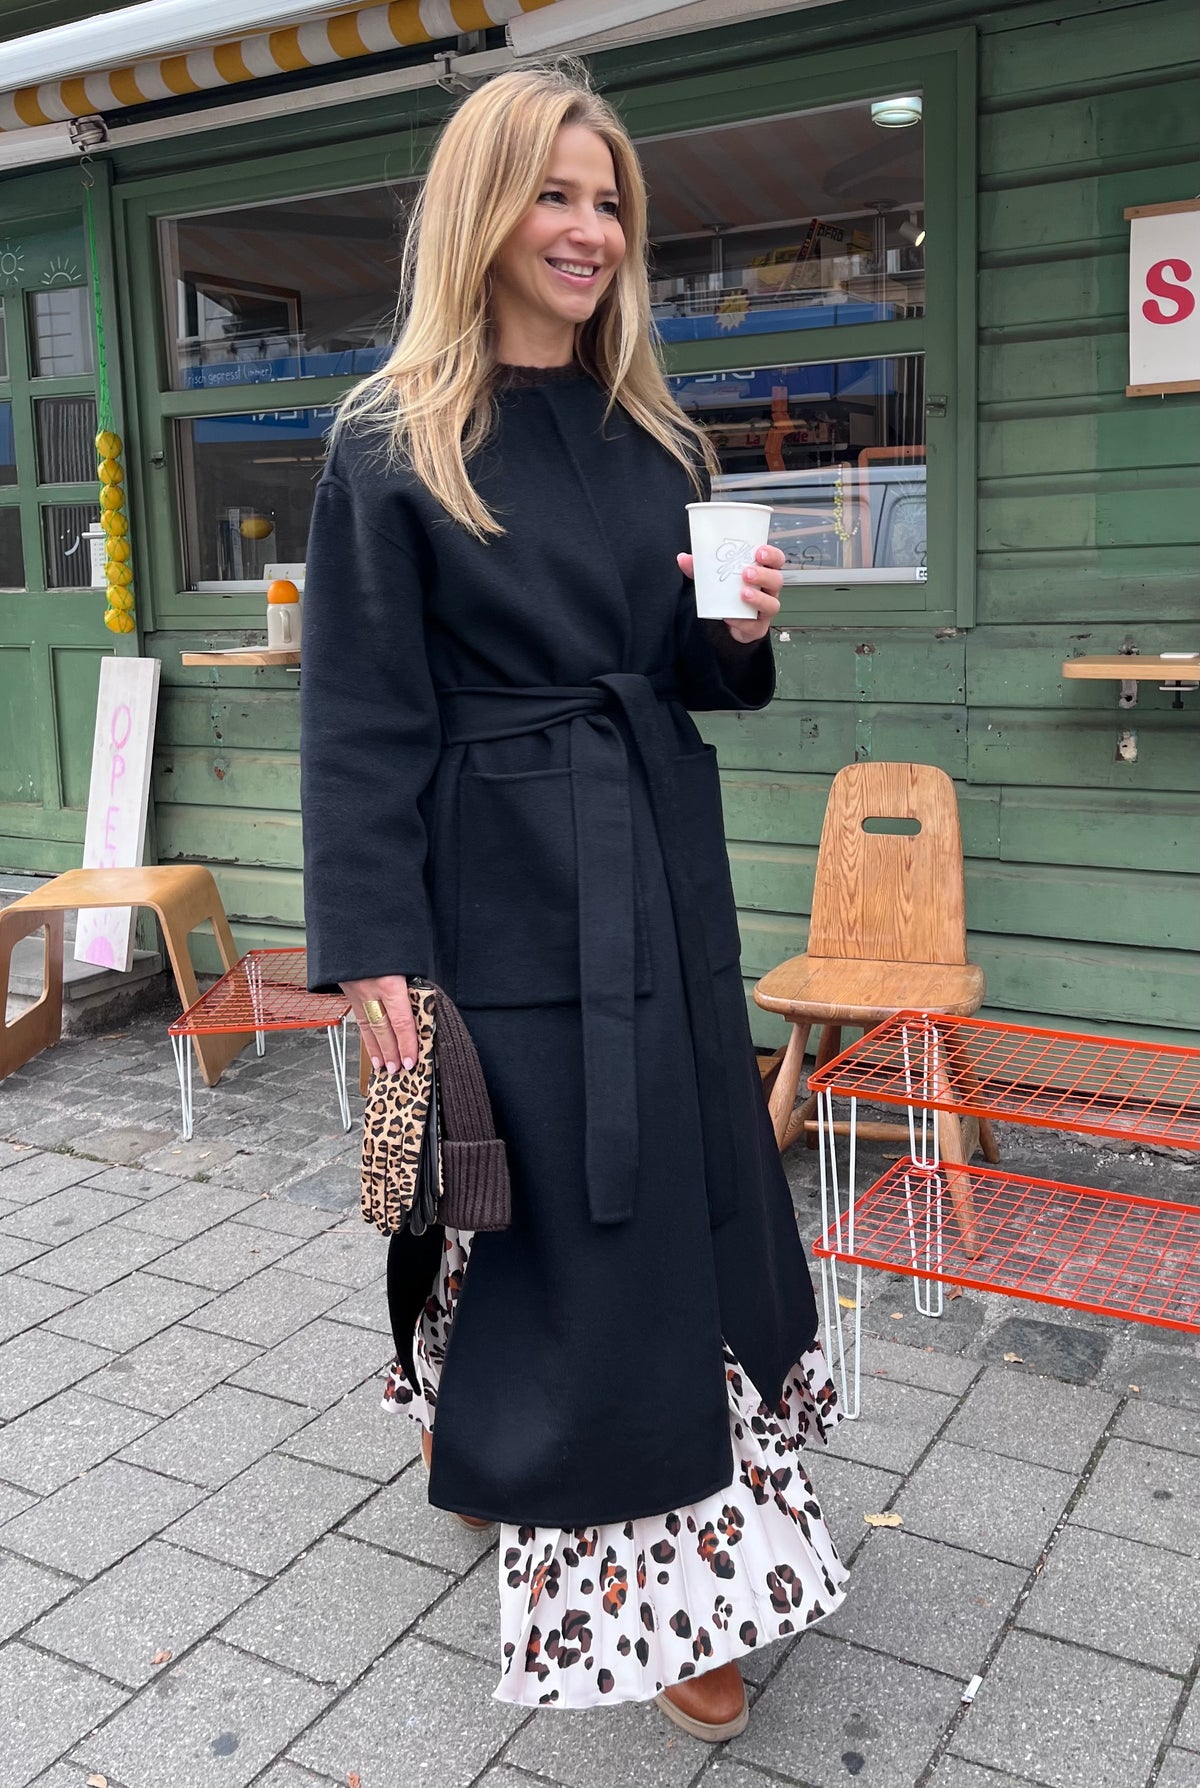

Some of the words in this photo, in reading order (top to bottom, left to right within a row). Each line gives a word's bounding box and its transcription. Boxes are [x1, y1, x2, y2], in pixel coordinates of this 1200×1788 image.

[1142, 258, 1195, 325] S
[208, 365, 241, 384] gepresst
[243, 363, 273, 380] (immer)
[99, 703, 132, 869] OPE
